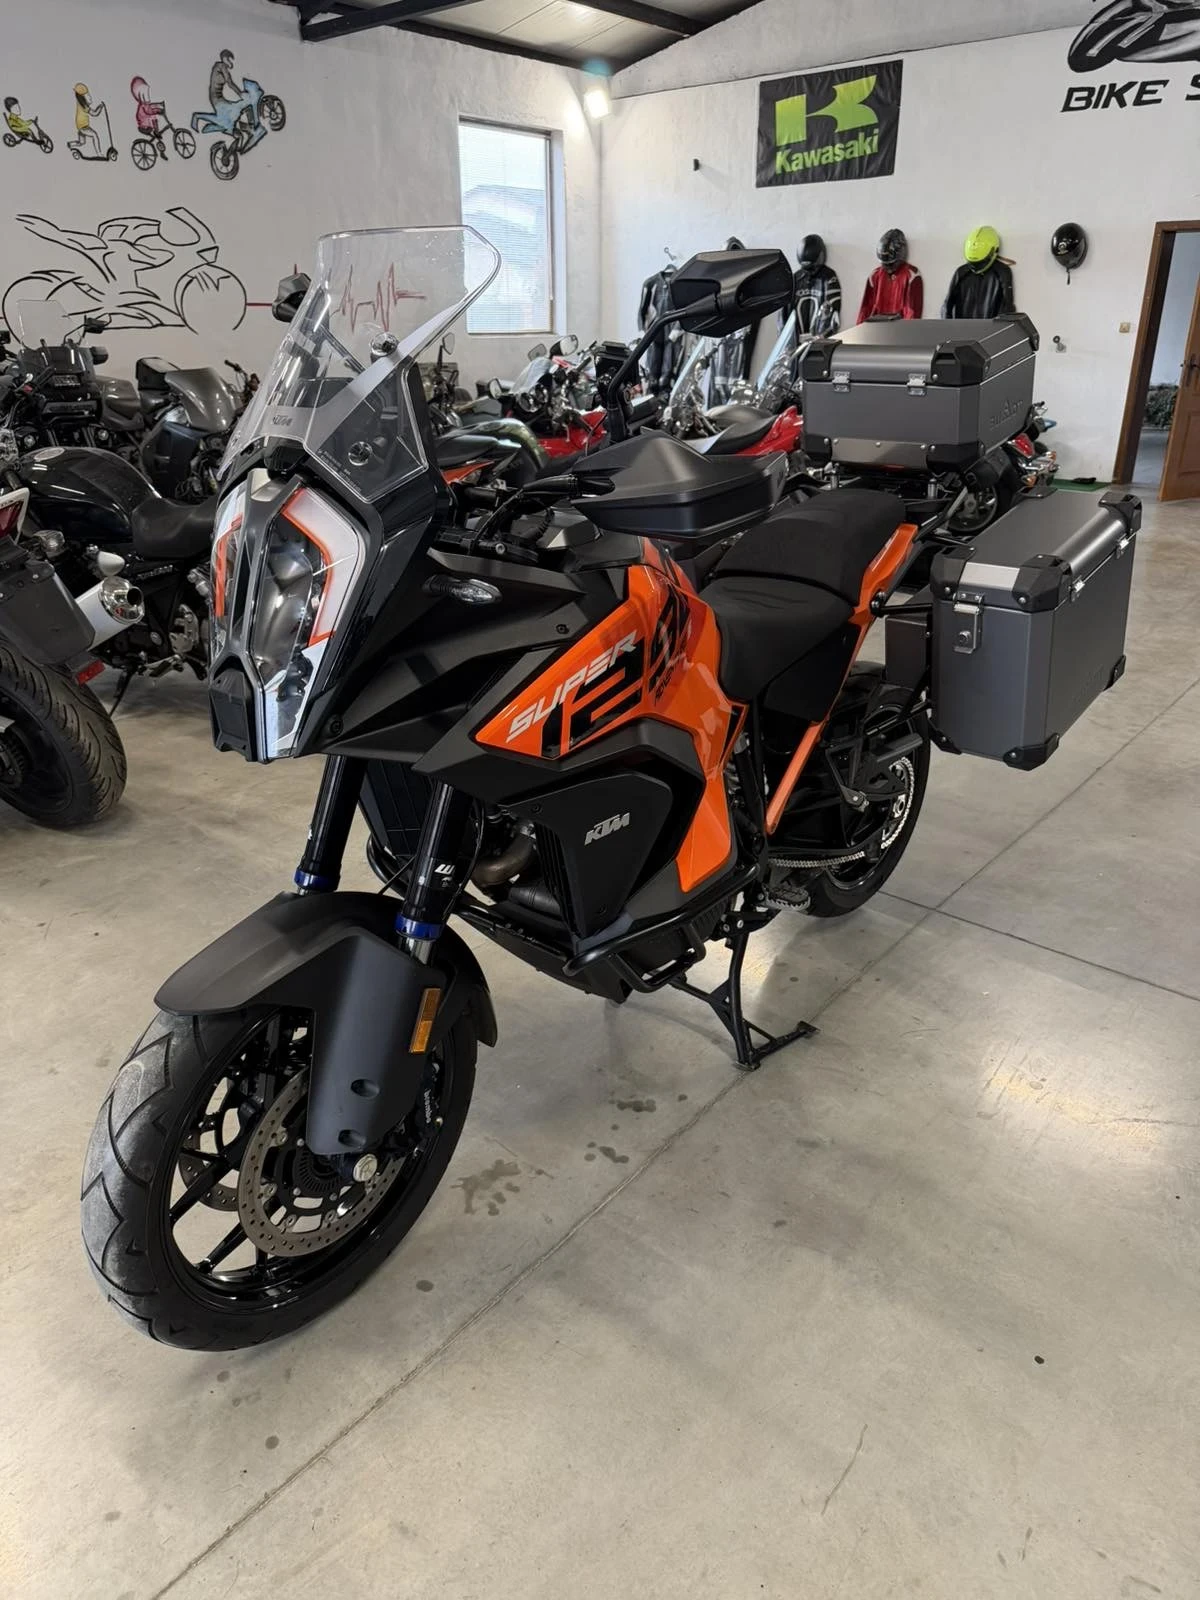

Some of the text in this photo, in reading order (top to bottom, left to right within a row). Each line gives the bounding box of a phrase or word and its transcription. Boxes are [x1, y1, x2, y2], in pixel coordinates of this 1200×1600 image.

[1060, 79, 1170, 112] BIKE
[775, 128, 879, 175] Kawasaki
[505, 630, 637, 743] SUPER
[584, 812, 630, 846] KTM
